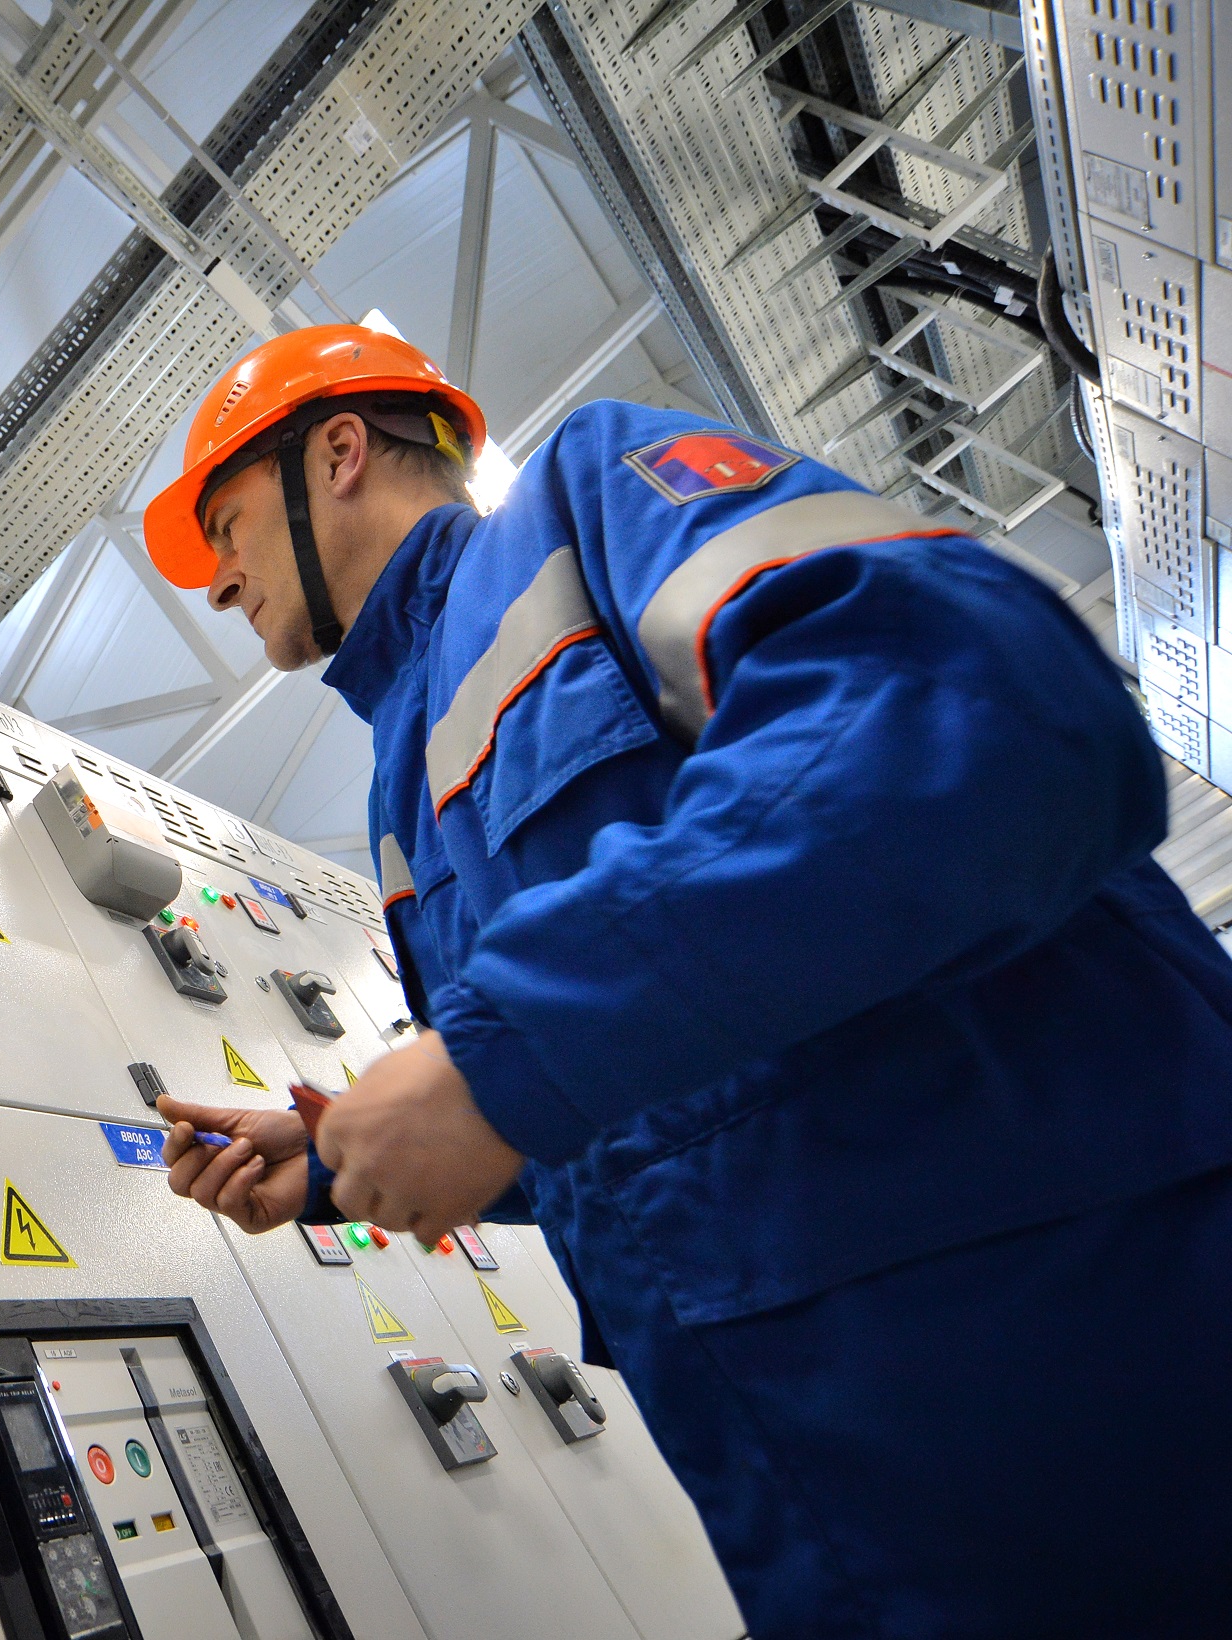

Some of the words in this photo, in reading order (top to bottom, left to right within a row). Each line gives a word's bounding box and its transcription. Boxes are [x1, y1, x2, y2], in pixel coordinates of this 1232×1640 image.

[120, 1130, 145, 1146] ВВОД
[144, 1134, 152, 1145] 3
[169, 1386, 197, 1399] Metasol
